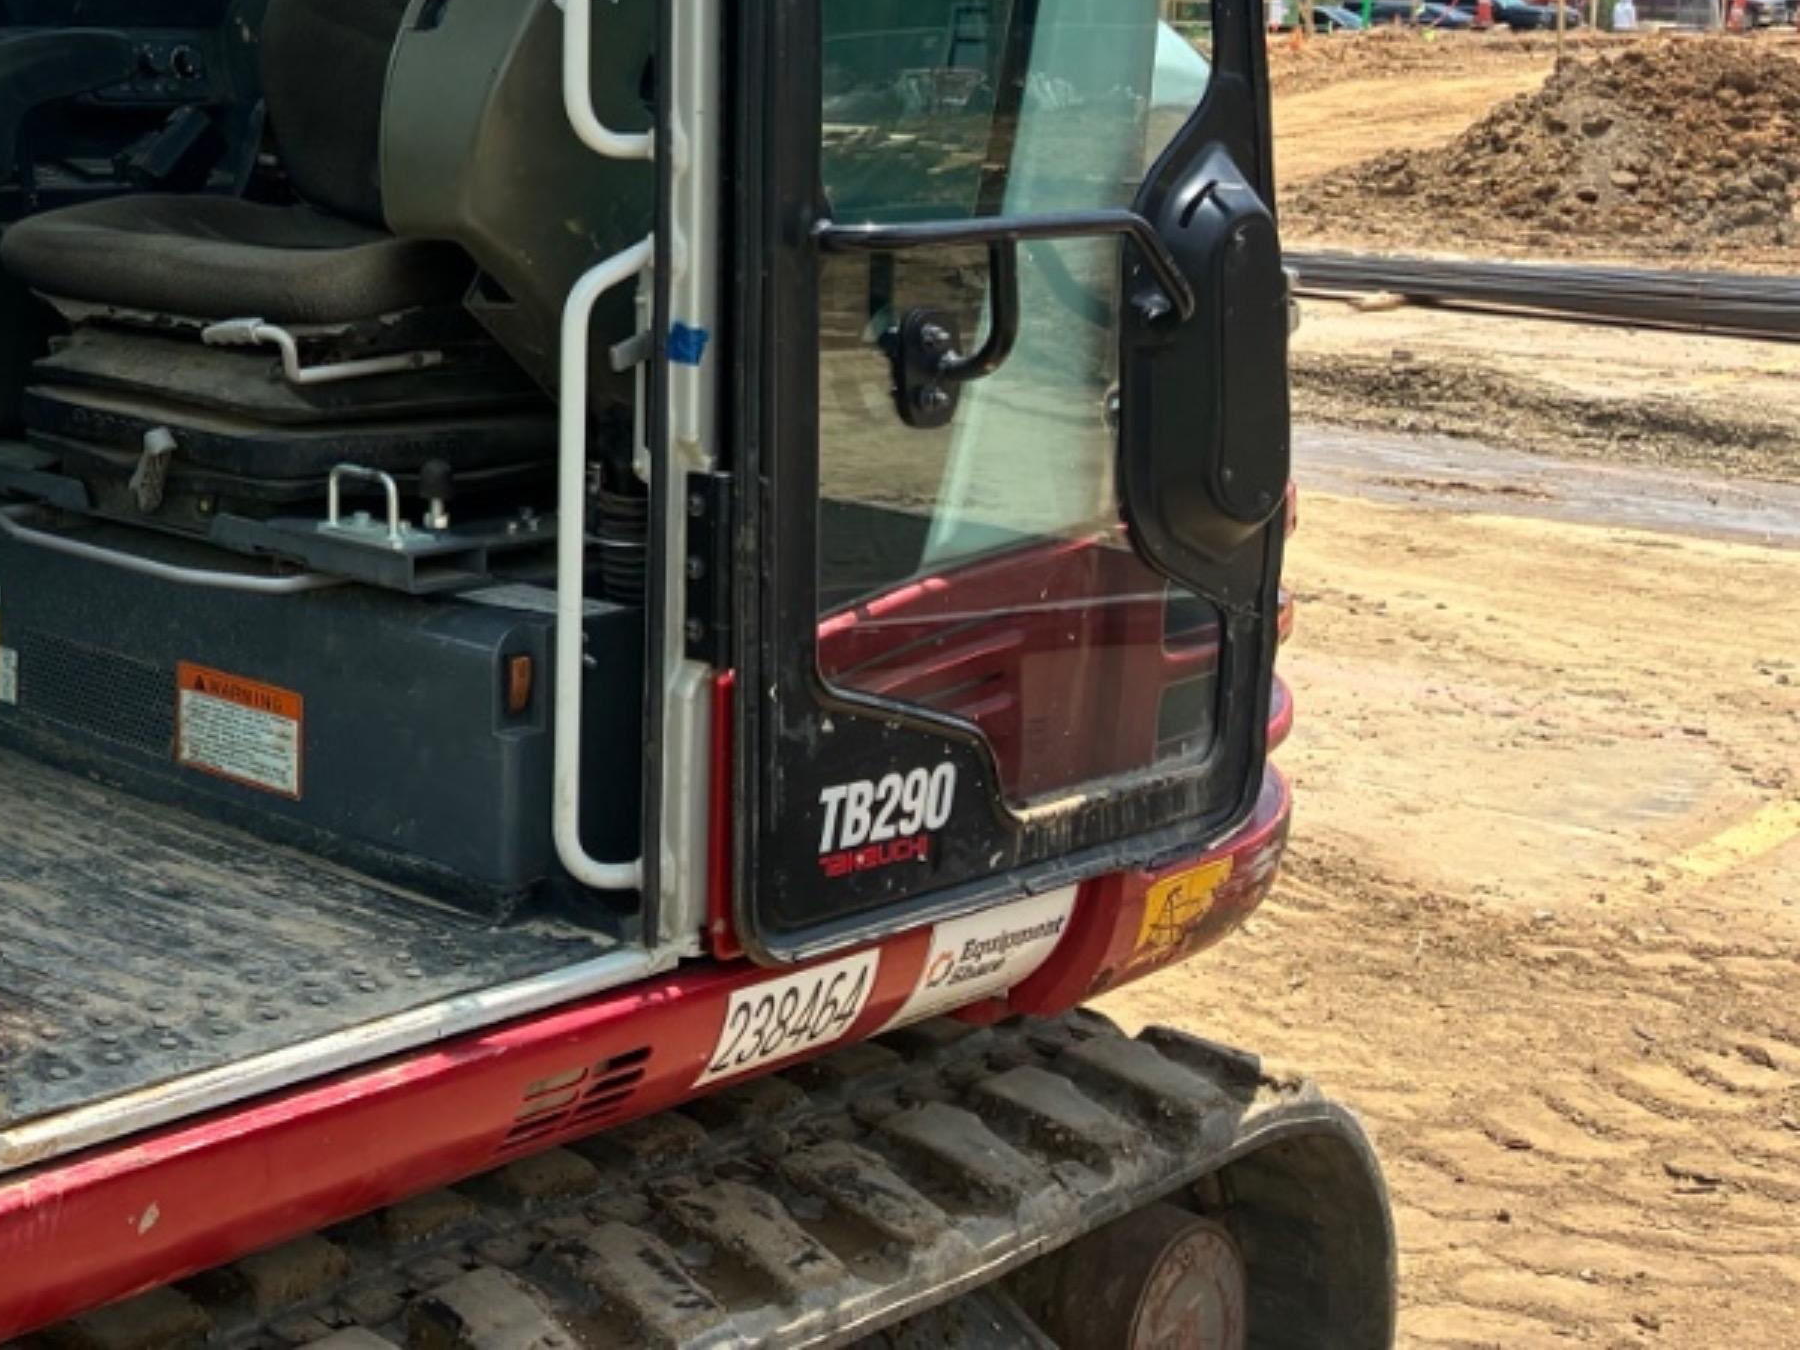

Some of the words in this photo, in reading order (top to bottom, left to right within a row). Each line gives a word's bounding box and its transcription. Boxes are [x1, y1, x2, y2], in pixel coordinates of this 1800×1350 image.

[818, 761, 956, 854] TB290
[960, 914, 1065, 962] Equipment
[709, 963, 868, 1074] 238464
